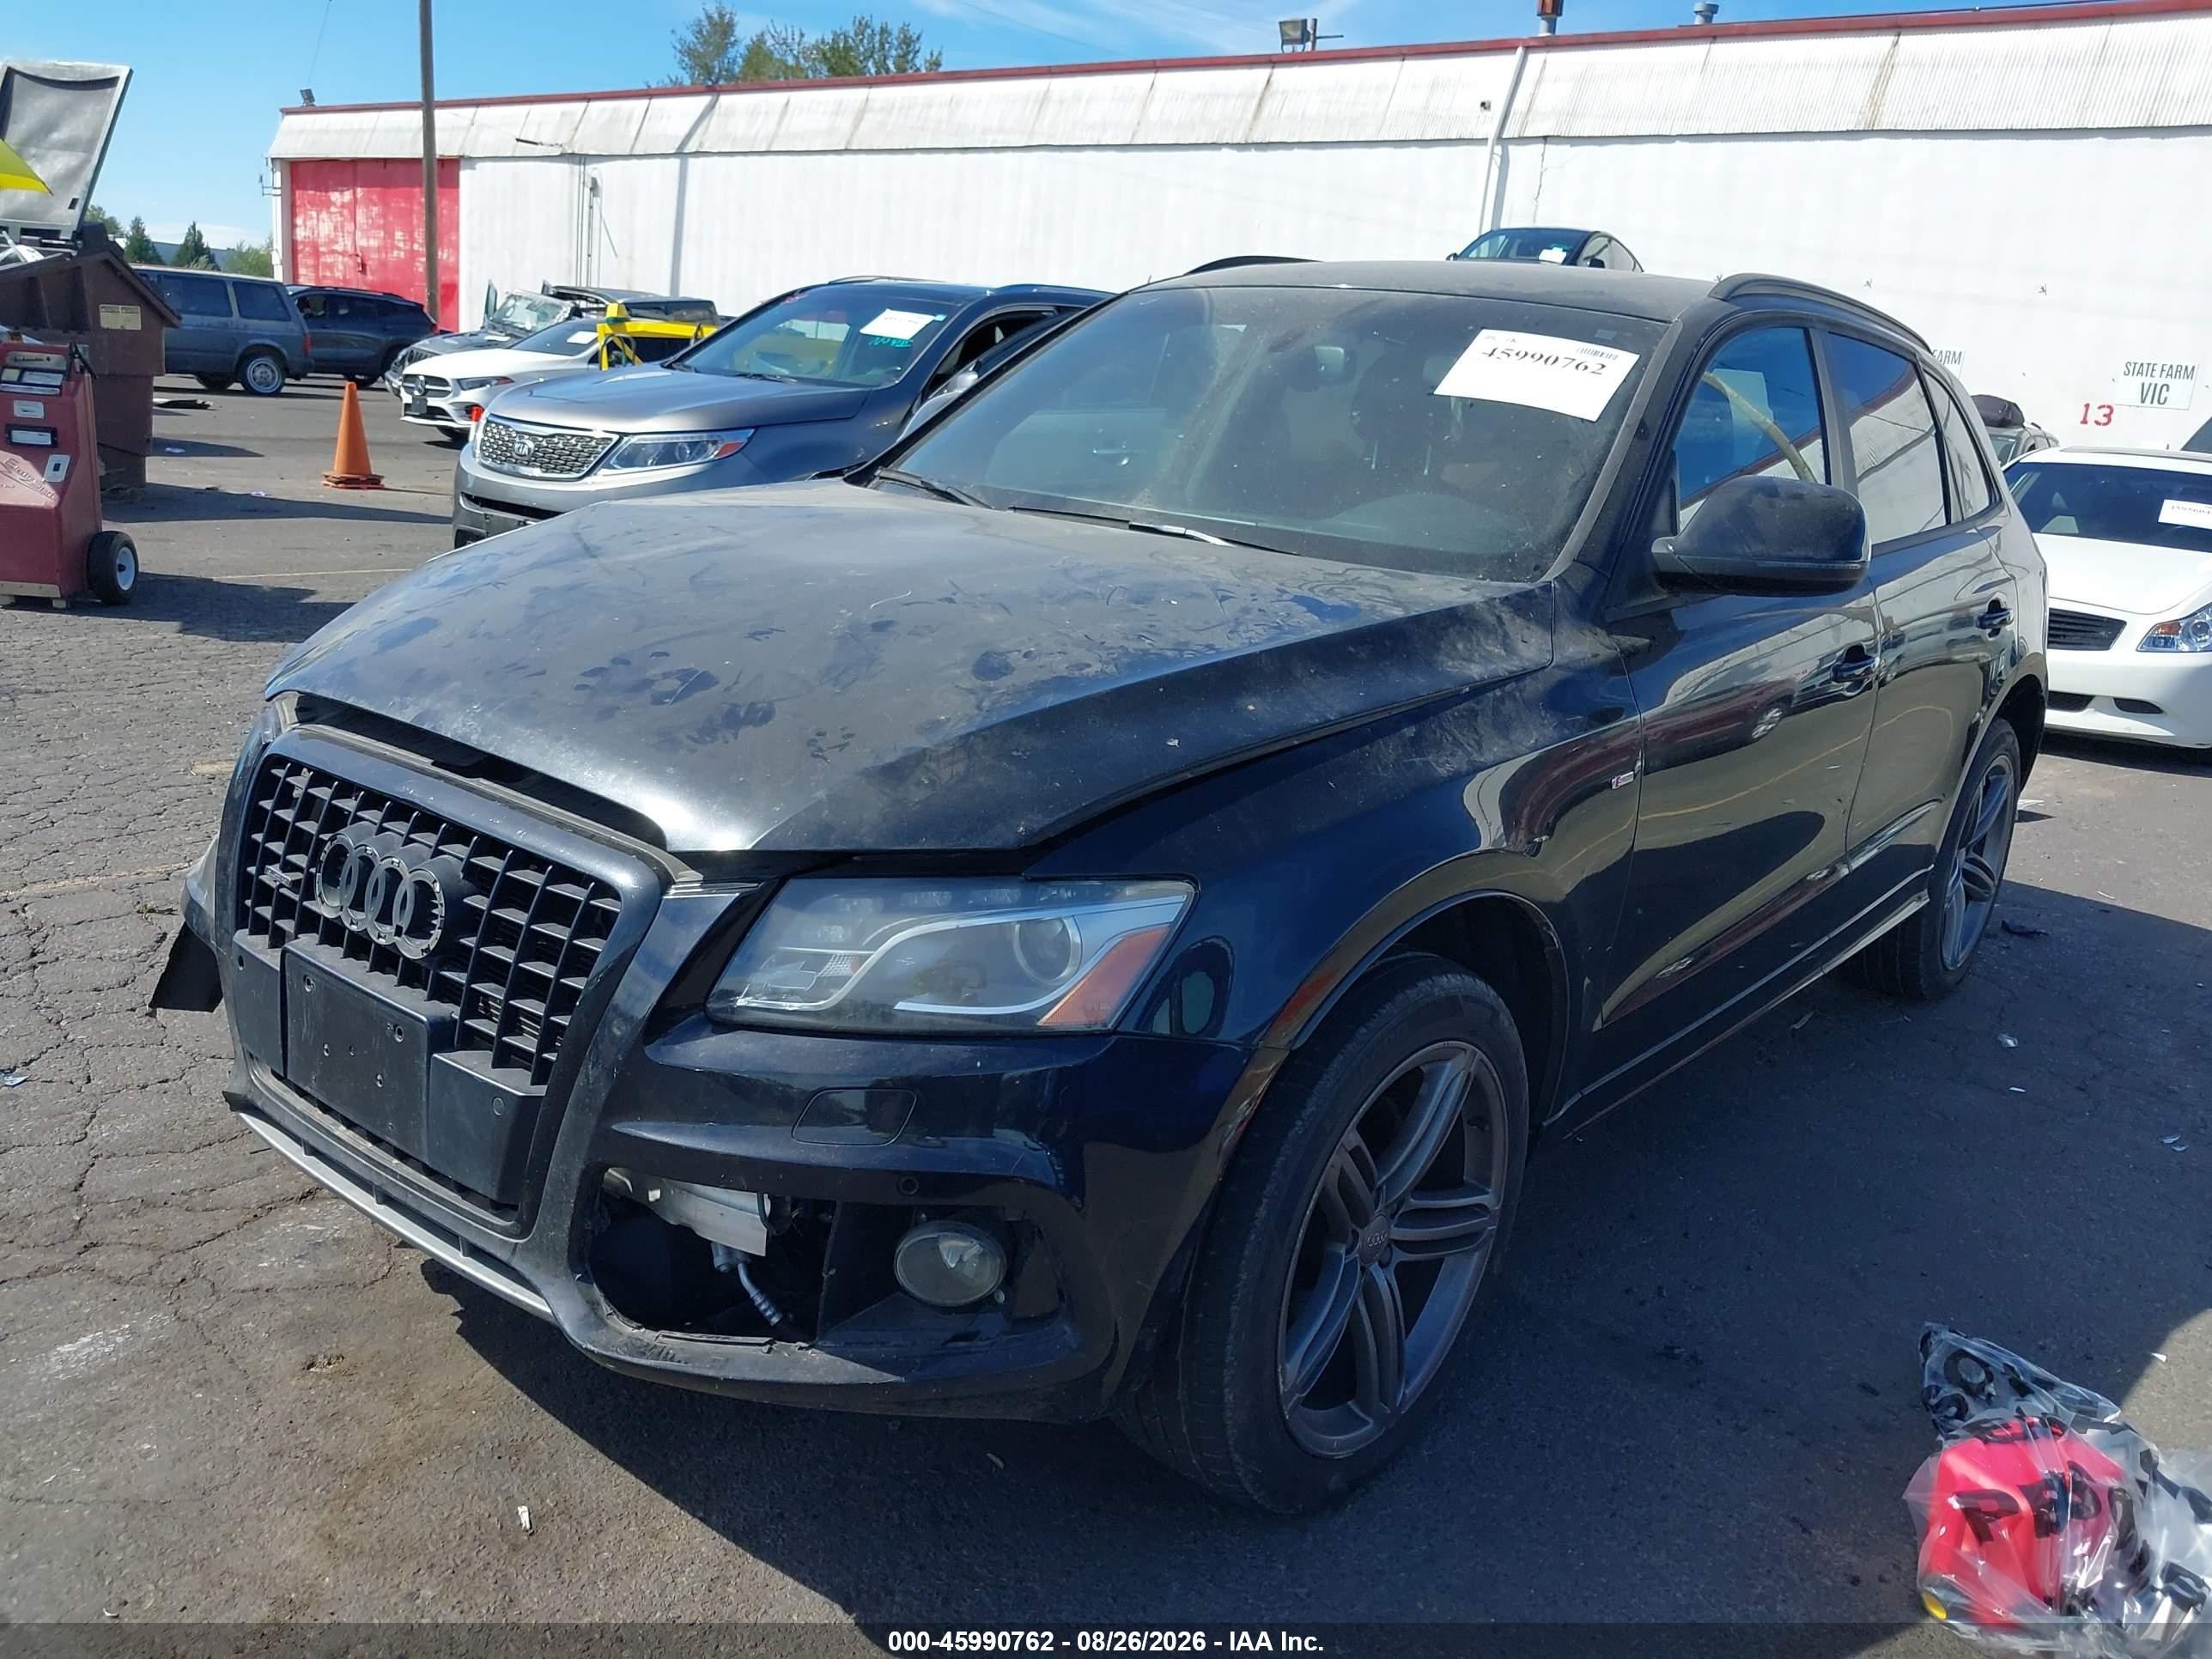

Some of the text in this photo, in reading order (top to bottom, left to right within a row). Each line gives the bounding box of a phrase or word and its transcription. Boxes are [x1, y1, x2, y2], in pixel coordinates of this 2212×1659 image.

[1482, 346, 1607, 375] 45990762
[2124, 361, 2196, 380] STATE FARM
[2140, 382, 2170, 405] VIC
[2080, 403, 2114, 427] 13
